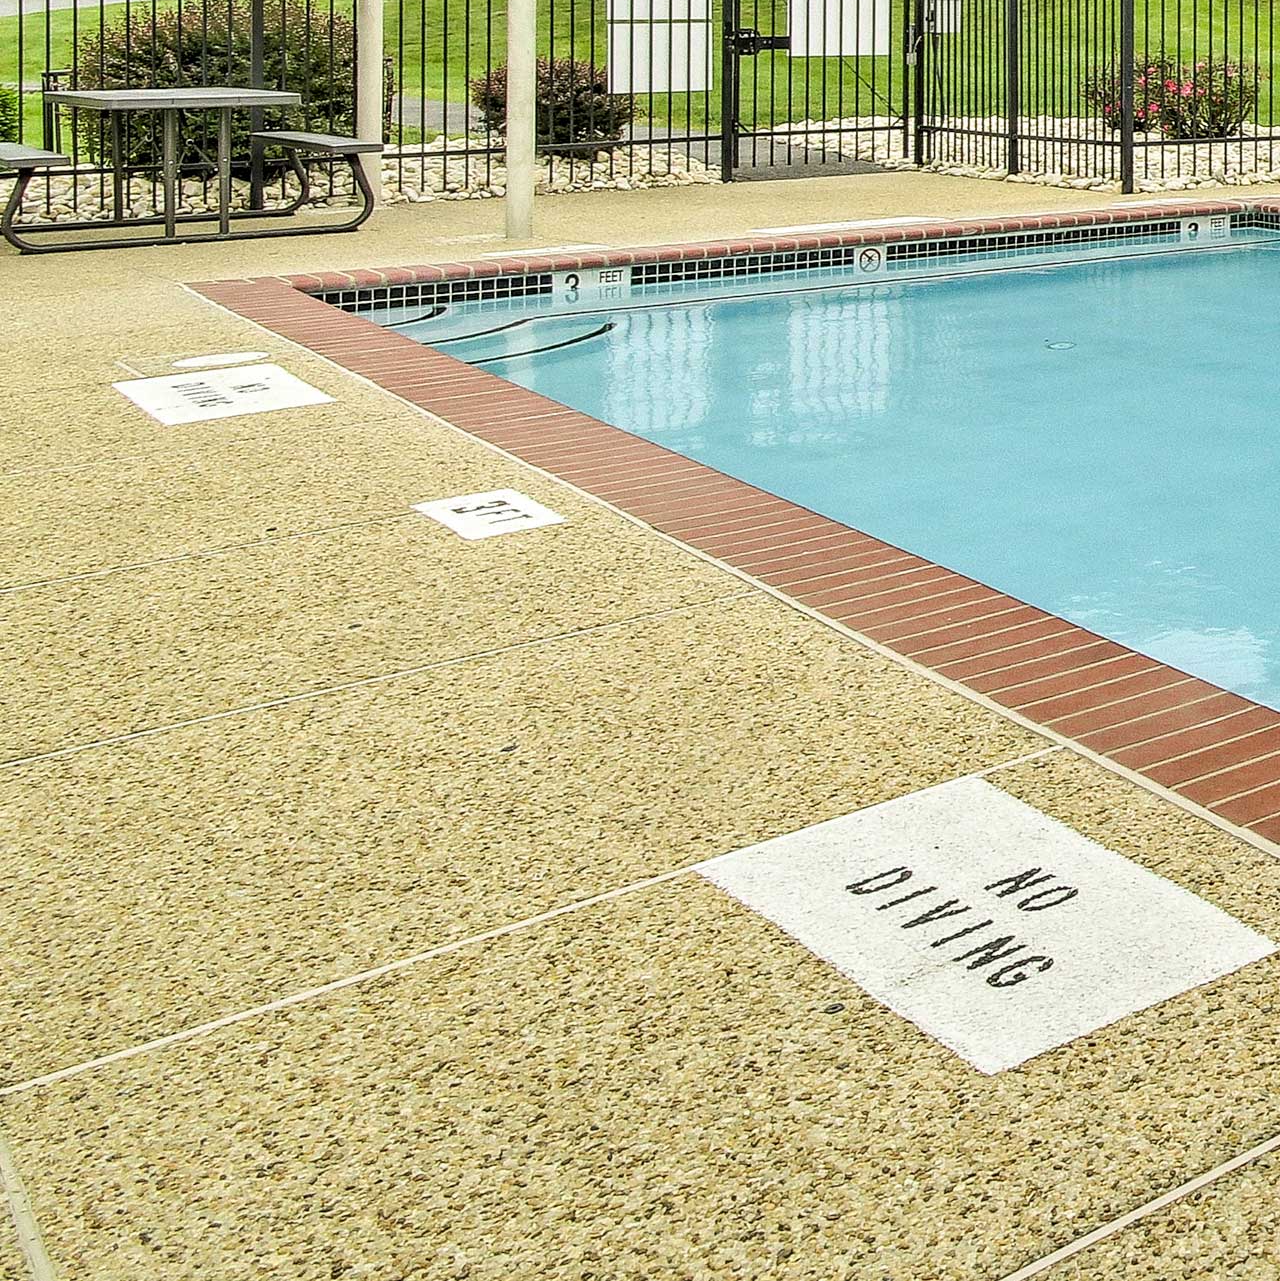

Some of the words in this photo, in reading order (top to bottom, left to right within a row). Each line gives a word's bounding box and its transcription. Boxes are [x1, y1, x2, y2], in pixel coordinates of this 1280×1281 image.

[599, 269, 624, 284] FEET
[985, 867, 1079, 912] NO
[845, 865, 1055, 989] DIVING
